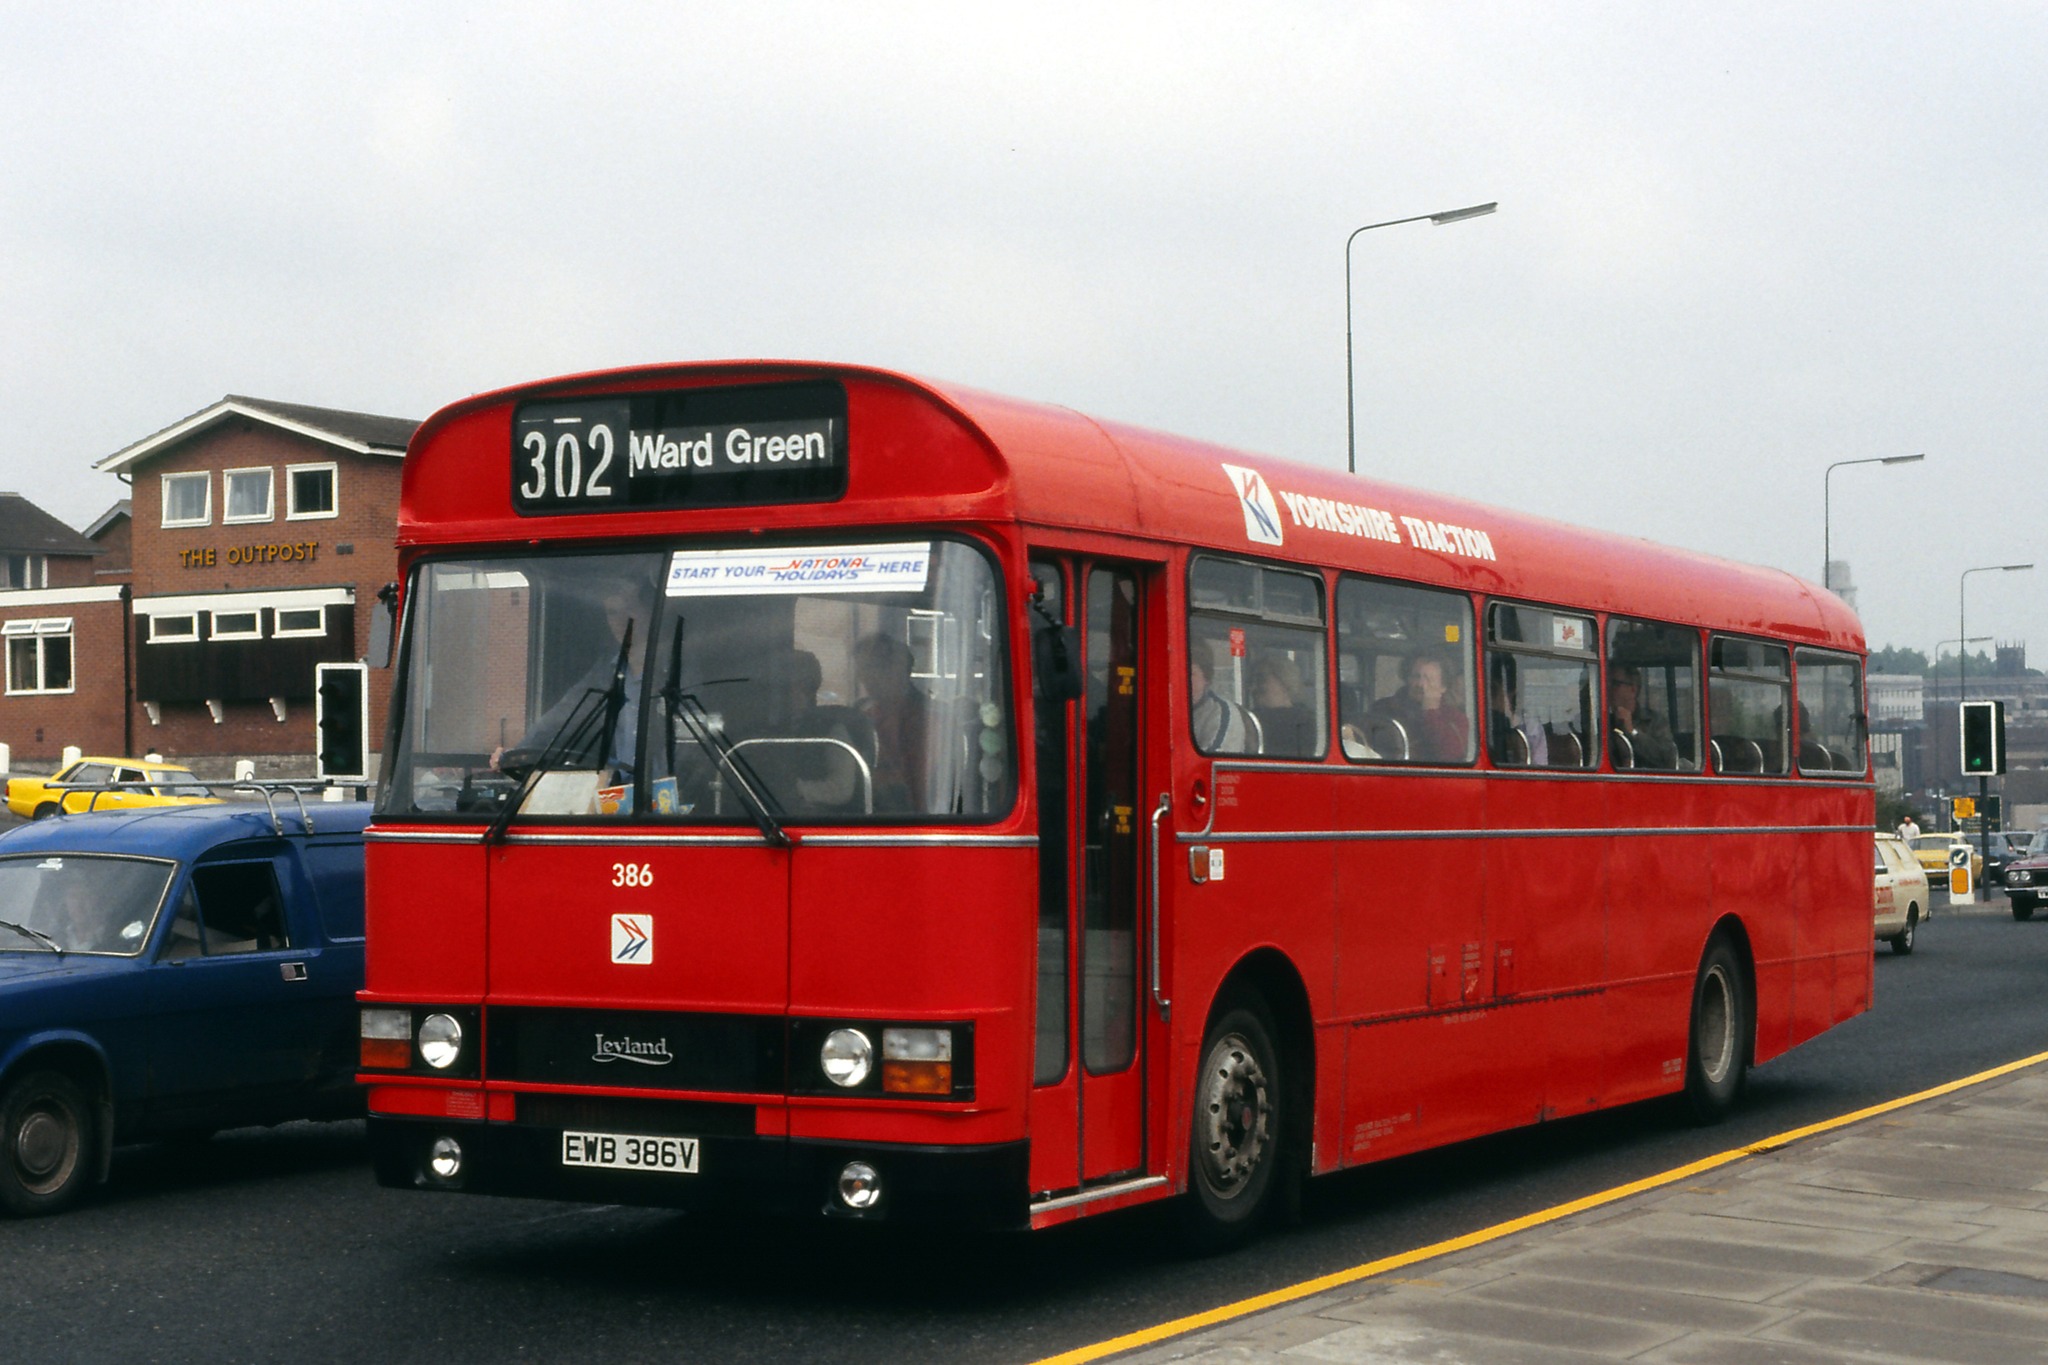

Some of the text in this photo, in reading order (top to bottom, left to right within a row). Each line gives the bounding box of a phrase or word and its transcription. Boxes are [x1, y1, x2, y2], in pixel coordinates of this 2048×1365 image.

[521, 424, 613, 498] 302
[632, 428, 825, 469] Ward Green
[1280, 490, 1496, 561] YORKSHIRE TRACTION
[179, 541, 319, 567] THE OUTPOST
[786, 556, 872, 570] NATIONAL
[877, 560, 924, 574] HERE
[672, 565, 766, 580] START YOUR
[772, 568, 860, 582] HOLIDAYS
[612, 863, 653, 887] 386
[592, 1033, 674, 1065] Leyland
[565, 1135, 695, 1169] EWB 386V
